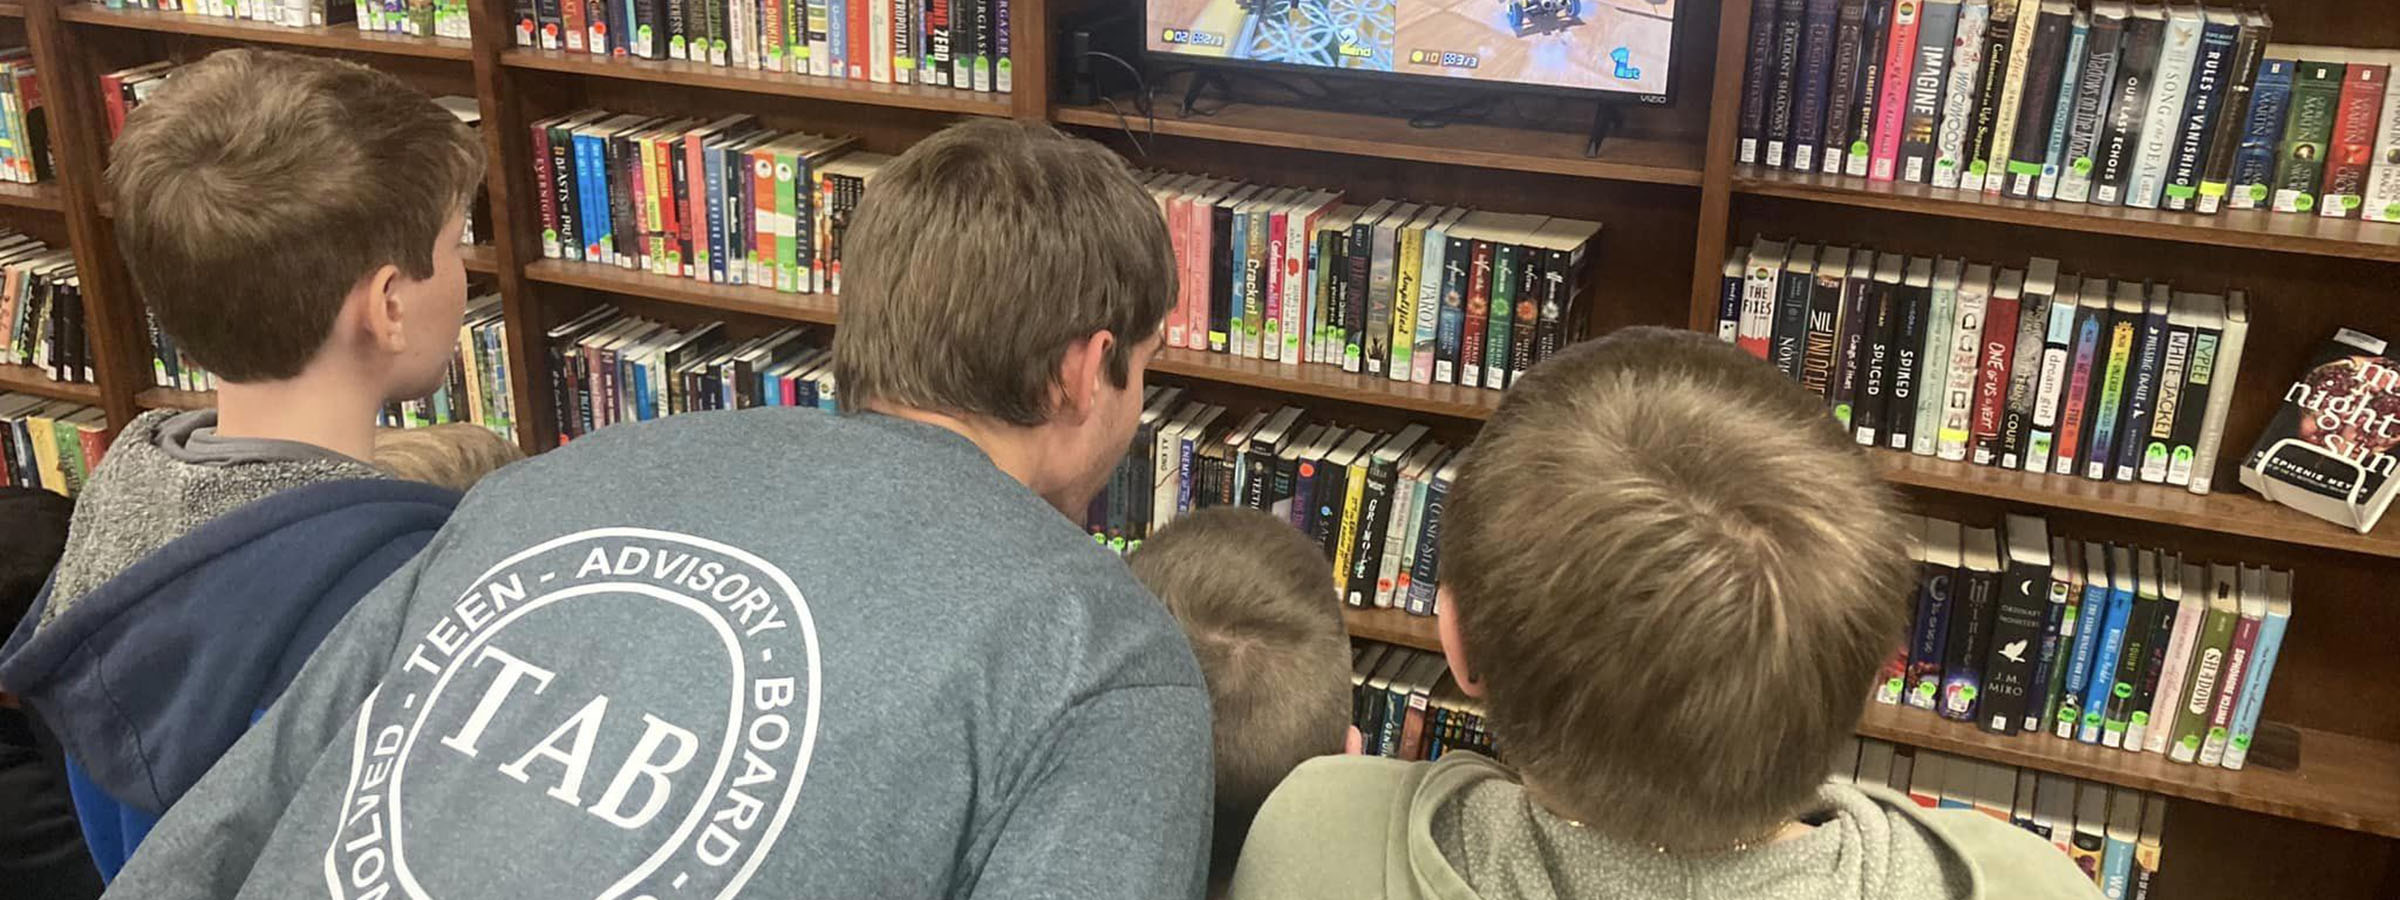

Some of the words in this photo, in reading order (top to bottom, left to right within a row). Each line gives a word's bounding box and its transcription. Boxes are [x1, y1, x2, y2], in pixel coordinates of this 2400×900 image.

[933, 28, 949, 62] ZERO
[1338, 28, 1372, 57] 2nd
[1424, 53, 1438, 63] 10
[1455, 54, 1477, 67] 3/3
[1780, 28, 1794, 78] RADIANT
[1609, 47, 1641, 80] 1st
[1837, 42, 1852, 89] DARKEST
[1912, 46, 1945, 115] IMAGINE
[1985, 43, 2004, 91] Confessions
[2082, 51, 2114, 95] Shadows
[2200, 51, 2221, 91] RULES
[1640, 94, 1667, 104] VIZIO
[1773, 79, 1787, 130] SHADOWS
[2080, 97, 2098, 111] on
[2124, 76, 2139, 102] OUR
[2157, 72, 2178, 116] SONG
[2196, 95, 2208, 110] FOR
[1944, 71, 1969, 152] WHICHWOOD
[1978, 106, 1992, 124] Ugly
[2055, 101, 2069, 130] GOOD
[2076, 112, 2098, 129] the
[2116, 106, 2130, 134] LAST
[2250, 91, 2270, 135] MARTIN
[2297, 95, 2317, 140] MARTIN
[2343, 97, 2363, 142] MARTIN
[1906, 117, 1933, 145] ME
[2176, 114, 2206, 185] VANISHING
[2104, 136, 2123, 180] ECHOES
[536, 158, 551, 229] EVERNIGHT
[555, 157, 569, 202] BEASTS
[560, 214, 573, 243] PREY
[1269, 240, 1282, 284] Confessions
[1245, 258, 1260, 315] Cracker!
[1397, 271, 1414, 335] Amplified
[1749, 285, 1768, 300] THE
[1419, 282, 1438, 331] TAROT
[1743, 299, 1772, 315] FIXES
[1809, 309, 1834, 333] NIL
[1867, 343, 1885, 395] SPLICED
[1894, 349, 1914, 398] SPIKED
[1988, 341, 2006, 371] ONE
[2165, 333, 2187, 376] WHITE
[2190, 337, 2215, 381] TYPEE
[1983, 382, 1998, 396] US
[1988, 370, 1998, 383] OF
[2043, 355, 2060, 393] dream
[1980, 404, 1995, 429] NEXT
[2038, 398, 2054, 419] girl
[2067, 408, 2081, 427] FIRE
[2153, 381, 2178, 437] JACKET
[2284, 381, 2400, 439] night
[2004, 413, 2020, 451] COURT
[1181, 445, 1191, 477] ENEMY
[2257, 451, 2324, 482] SEPHENIE
[2327, 477, 2368, 493] MEYR
[2324, 434, 2398, 478] Sun
[2084, 616, 2096, 634] STARS
[2078, 634, 2093, 661] BENEATH
[2126, 642, 2141, 672] SQUINT
[2075, 661, 2086, 674] OUR
[2192, 651, 2220, 709] SHADOW
[402, 572, 526, 678] TEEN
[576, 546, 787, 639] ADVISORY
[697, 675, 795, 867] BOARD
[1987, 683, 2024, 697] MIRO
[440, 645, 700, 830] TAB
